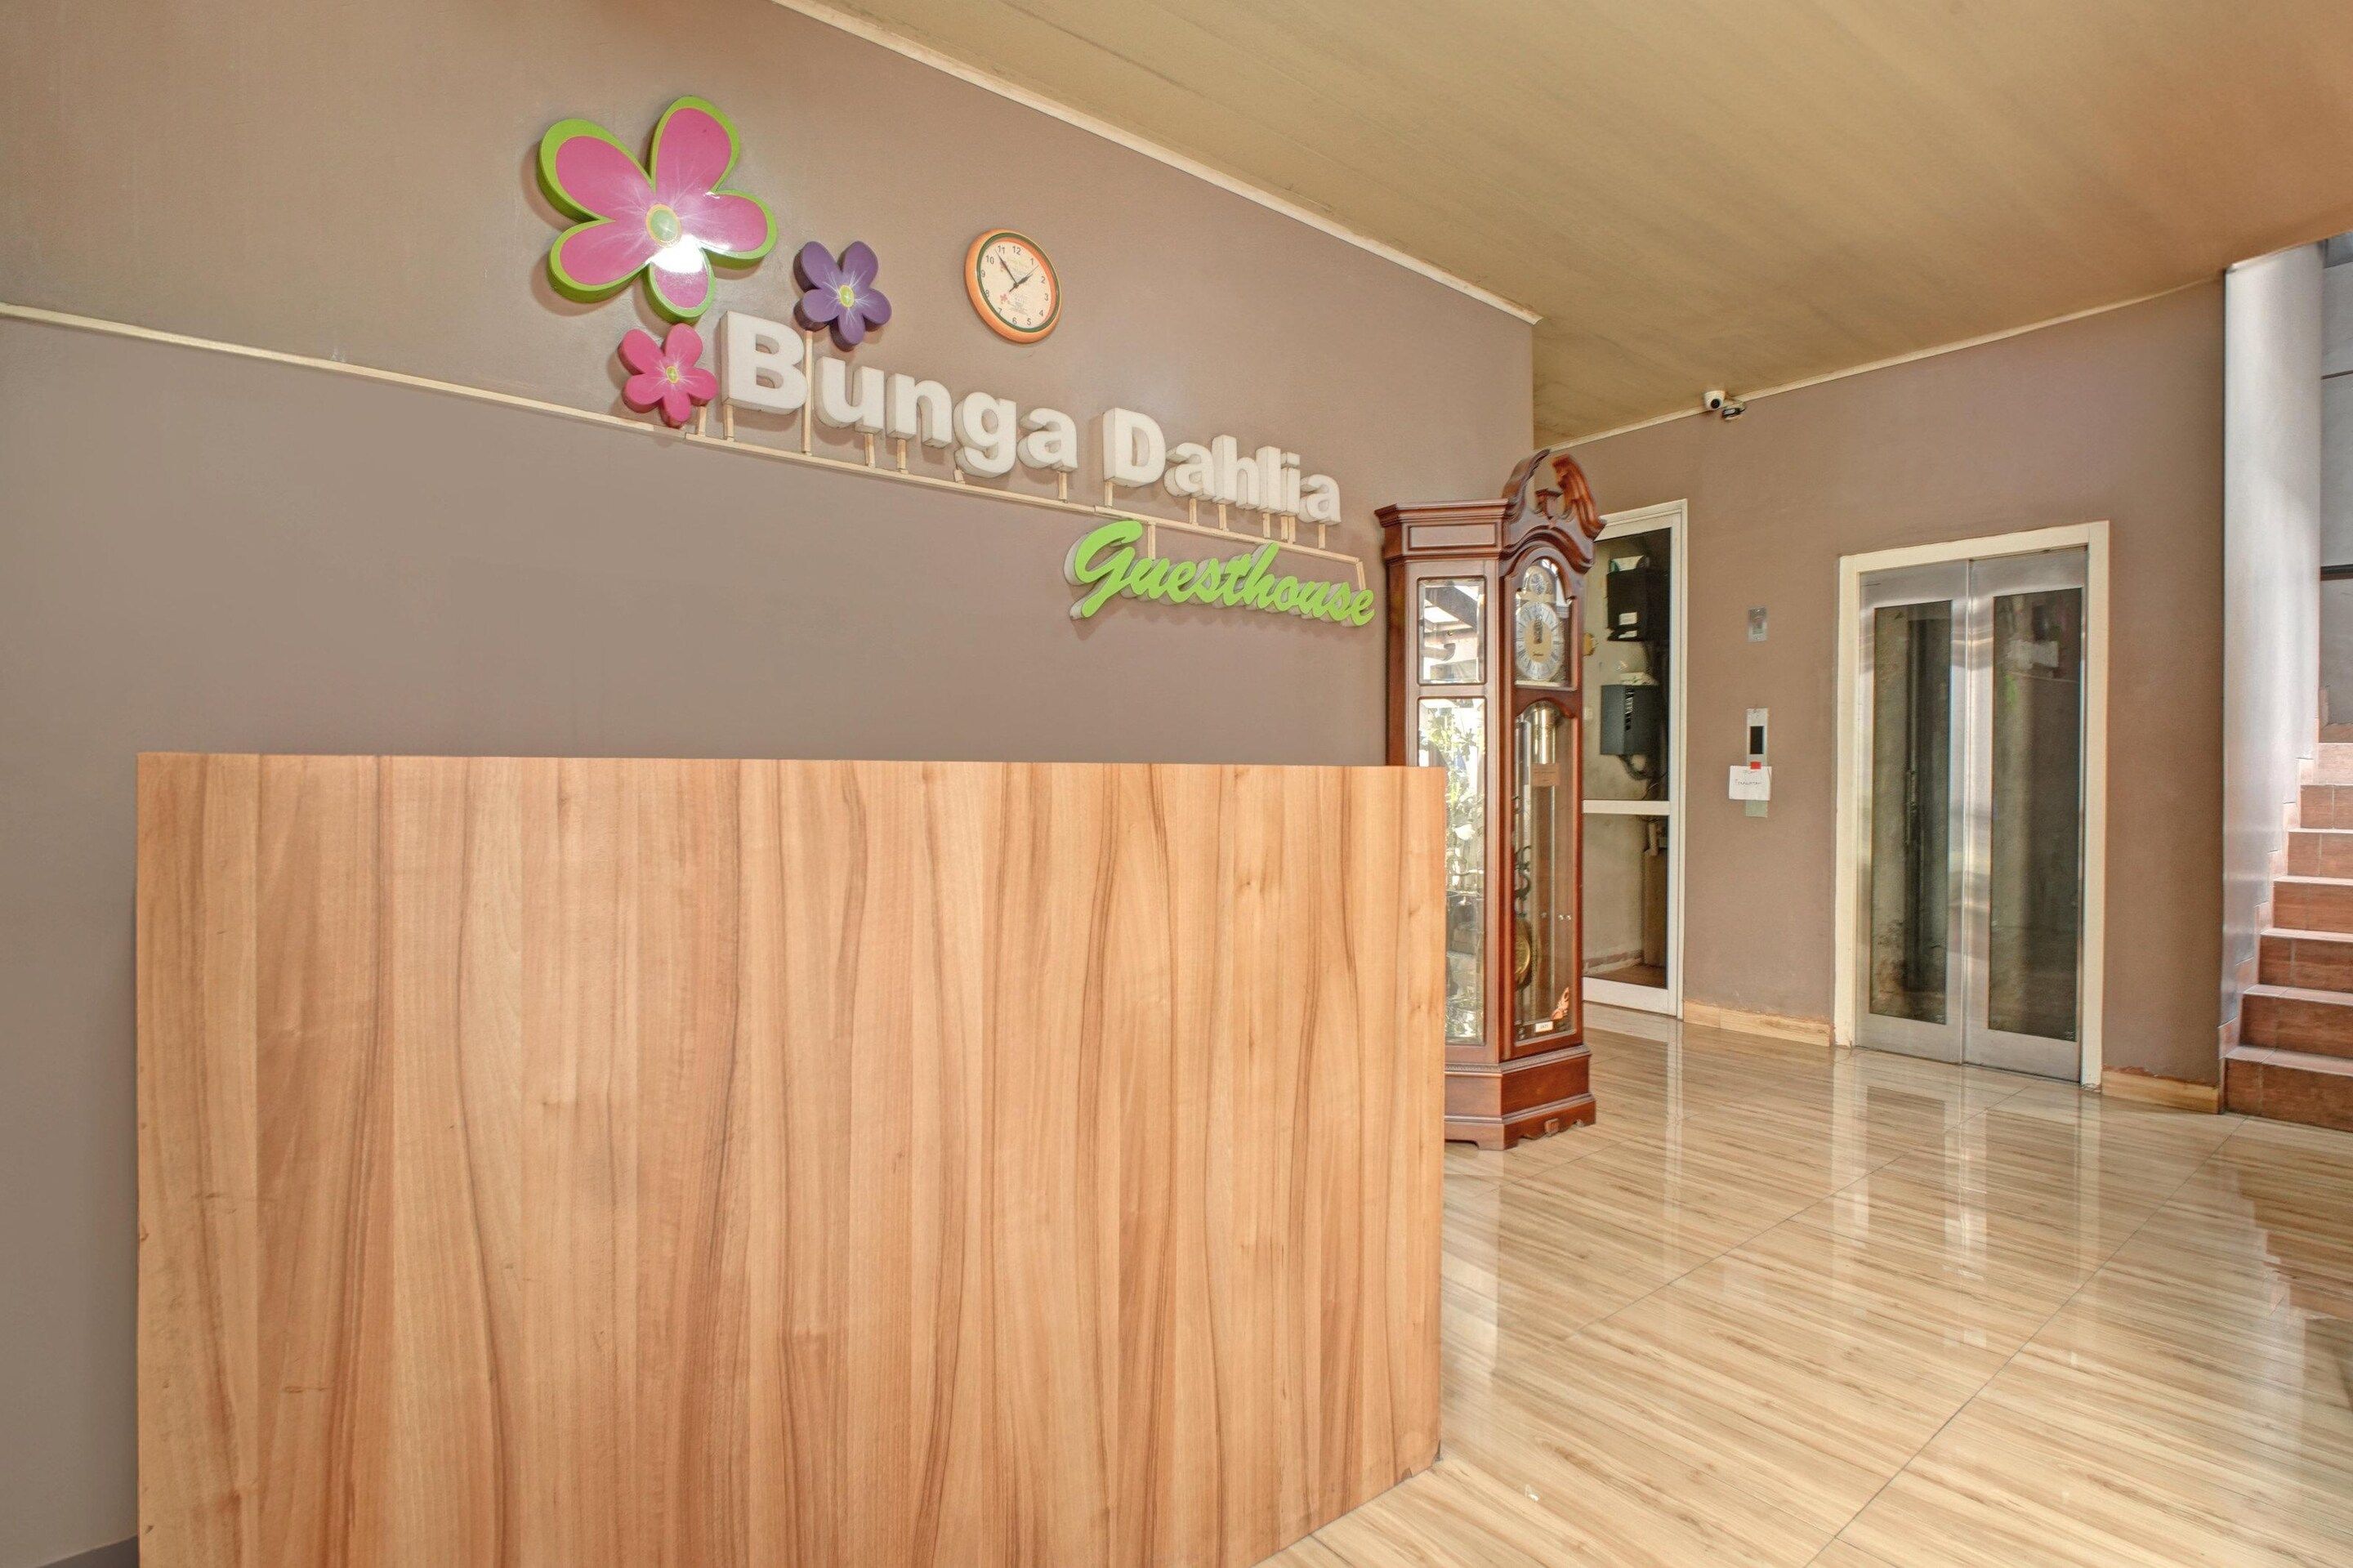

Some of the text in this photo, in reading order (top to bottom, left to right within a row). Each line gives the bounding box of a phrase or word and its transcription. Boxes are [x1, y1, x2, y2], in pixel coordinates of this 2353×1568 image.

[997, 245, 1006, 255] 11
[1012, 246, 1021, 256] 12
[985, 255, 995, 265] 10
[980, 270, 986, 278] 9
[1041, 275, 1046, 284] 2
[1044, 293, 1049, 302] 3
[1011, 316, 1018, 325] 6
[1026, 318, 1032, 326] 5
[721, 310, 1342, 525] Bunga Dahlia
[1064, 520, 1375, 627] Guesthouse
